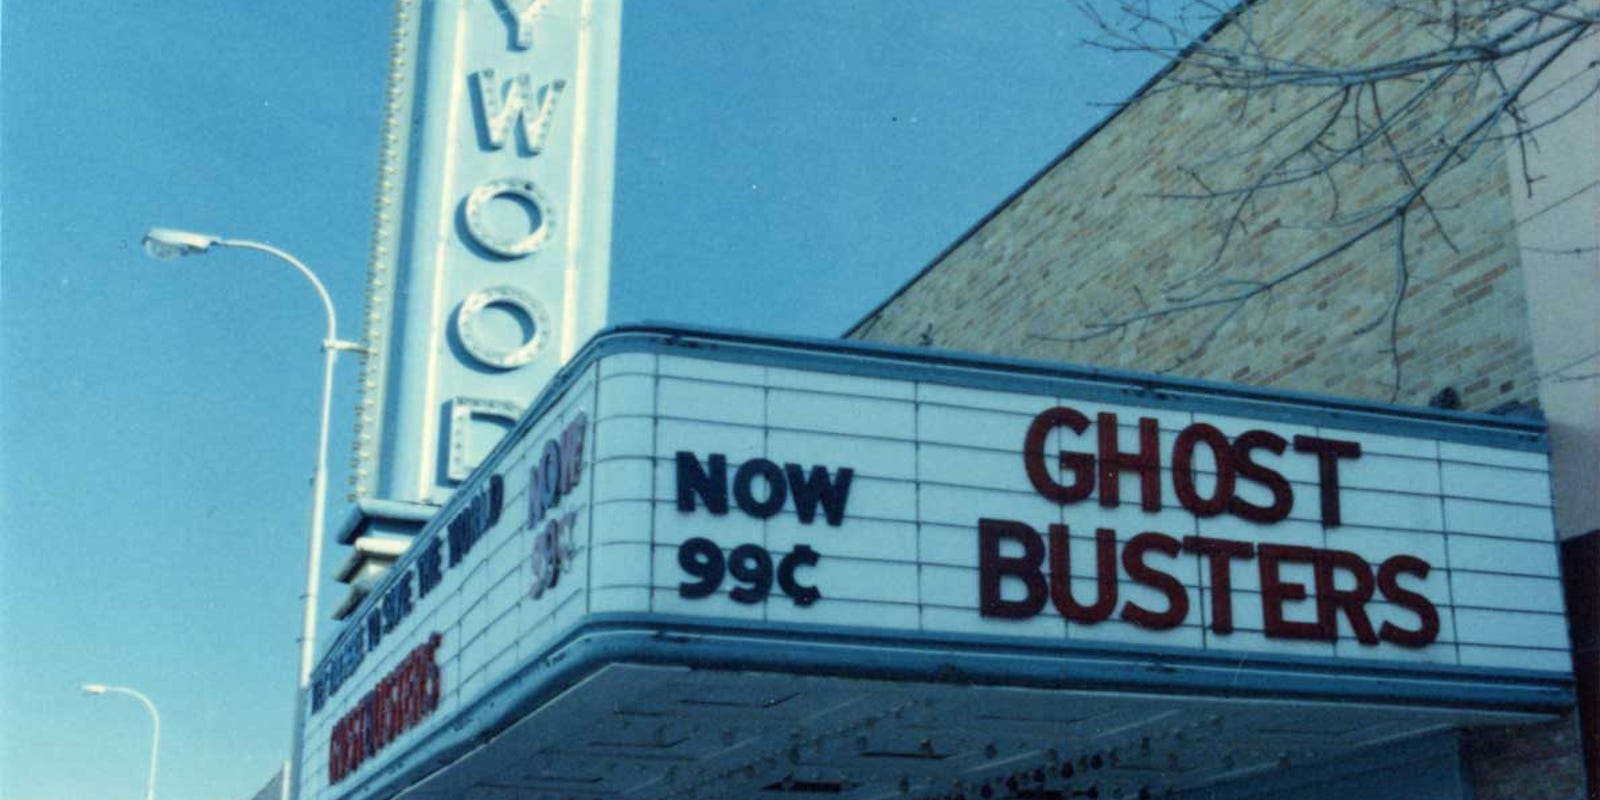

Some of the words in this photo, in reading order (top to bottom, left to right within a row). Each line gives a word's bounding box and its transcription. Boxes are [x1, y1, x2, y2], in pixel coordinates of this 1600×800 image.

[675, 450, 853, 527] NOW
[1024, 406, 1362, 527] GHOST
[447, 473, 504, 570] WORLD
[678, 537, 821, 607] 99¢
[978, 517, 1440, 648] BUSTERS
